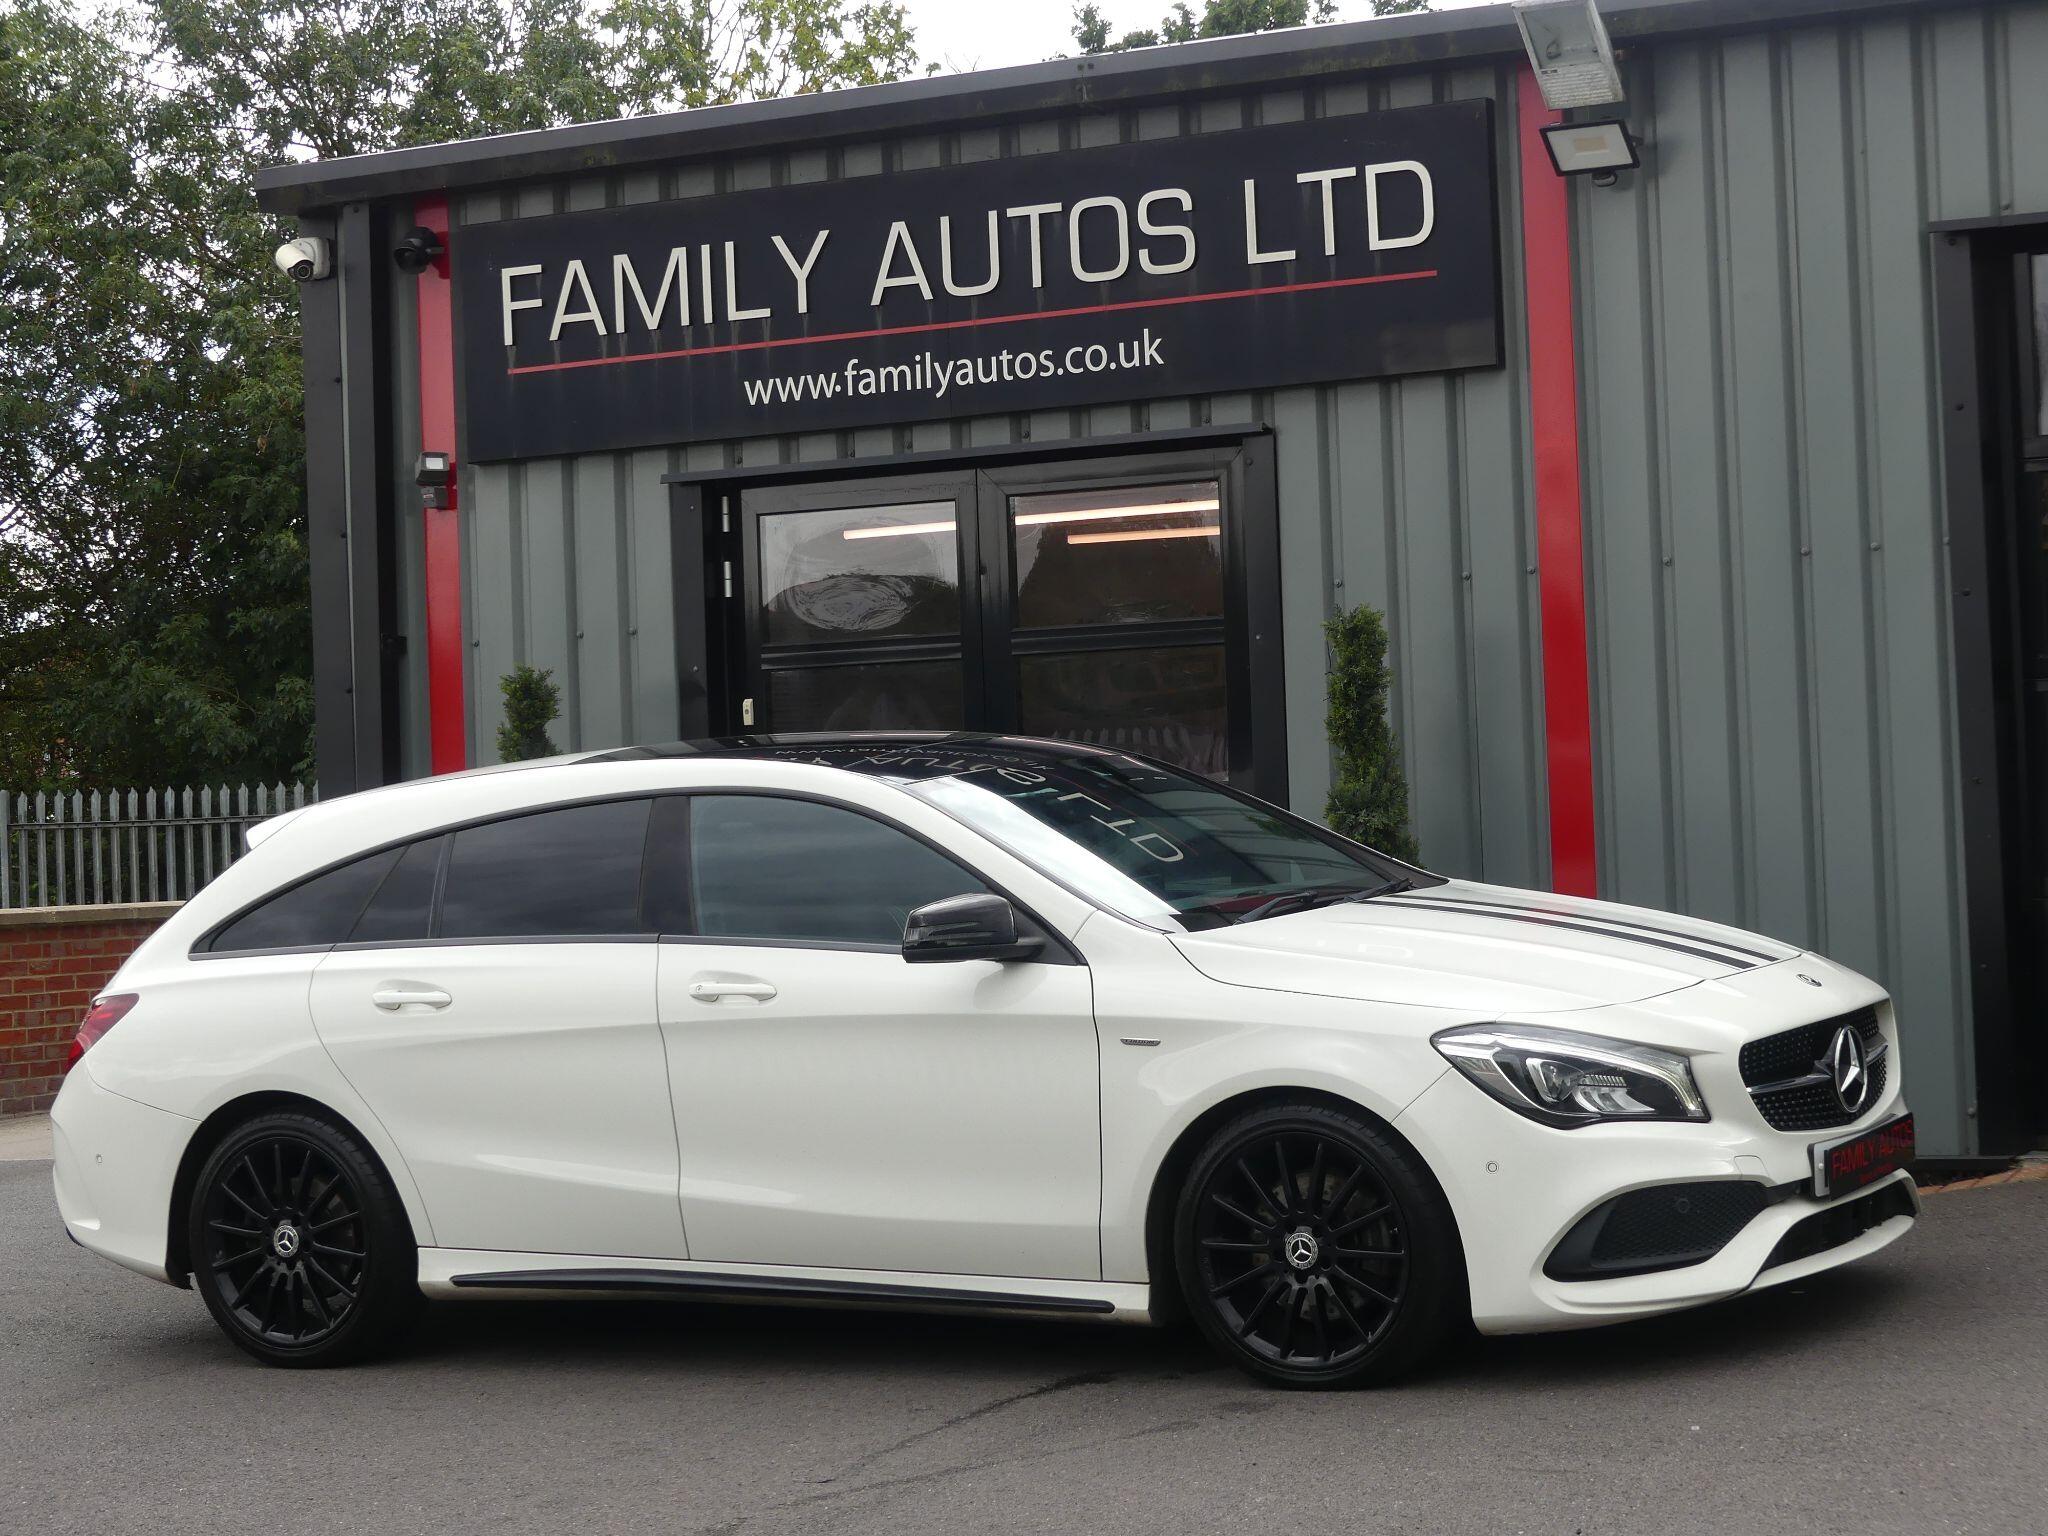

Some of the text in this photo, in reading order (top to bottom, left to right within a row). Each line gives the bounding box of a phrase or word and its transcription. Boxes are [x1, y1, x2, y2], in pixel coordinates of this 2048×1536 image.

[501, 160, 1434, 346] FAMILY AUTOS LTD
[744, 328, 1164, 406] www.familyautos.co.uk
[1832, 1138, 1876, 1180] FAMILY
[1878, 1119, 1914, 1154] AUTOS
